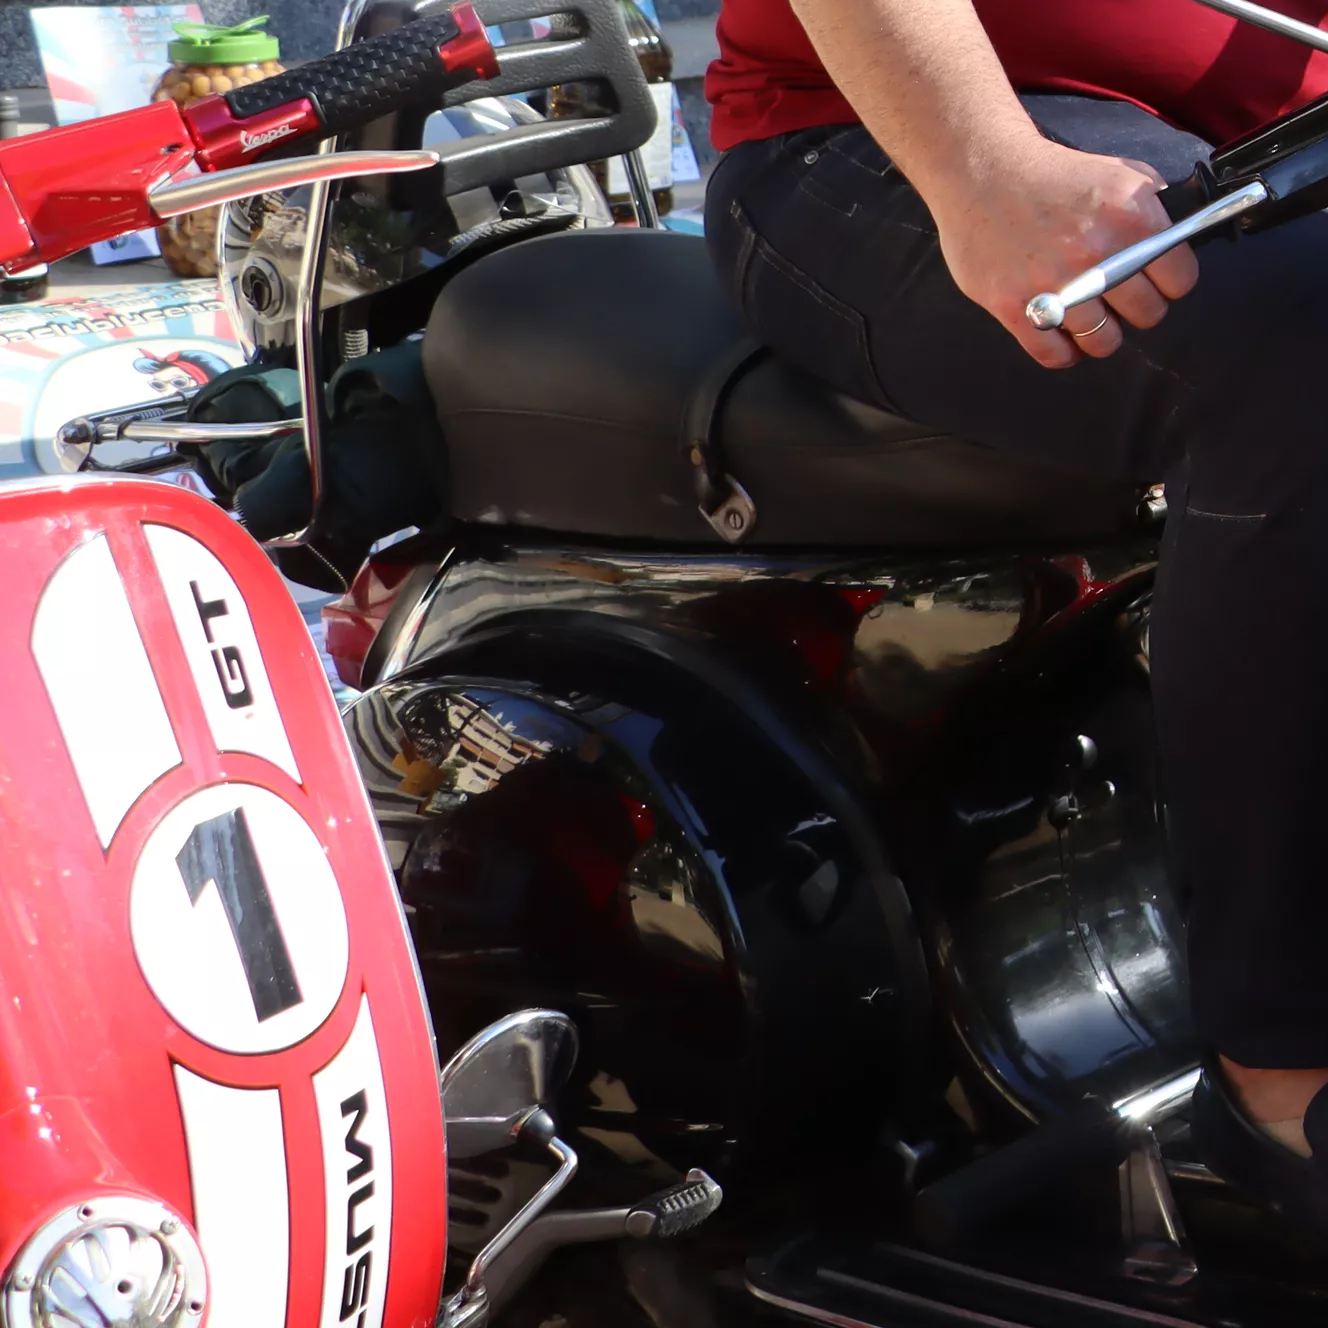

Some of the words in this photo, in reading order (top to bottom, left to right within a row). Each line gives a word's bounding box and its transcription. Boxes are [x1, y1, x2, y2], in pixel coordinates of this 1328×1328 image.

[240, 123, 299, 154] Vespa
[188, 579, 254, 710] GT
[175, 805, 304, 1024] 1
[339, 1087, 375, 1328] MUS
